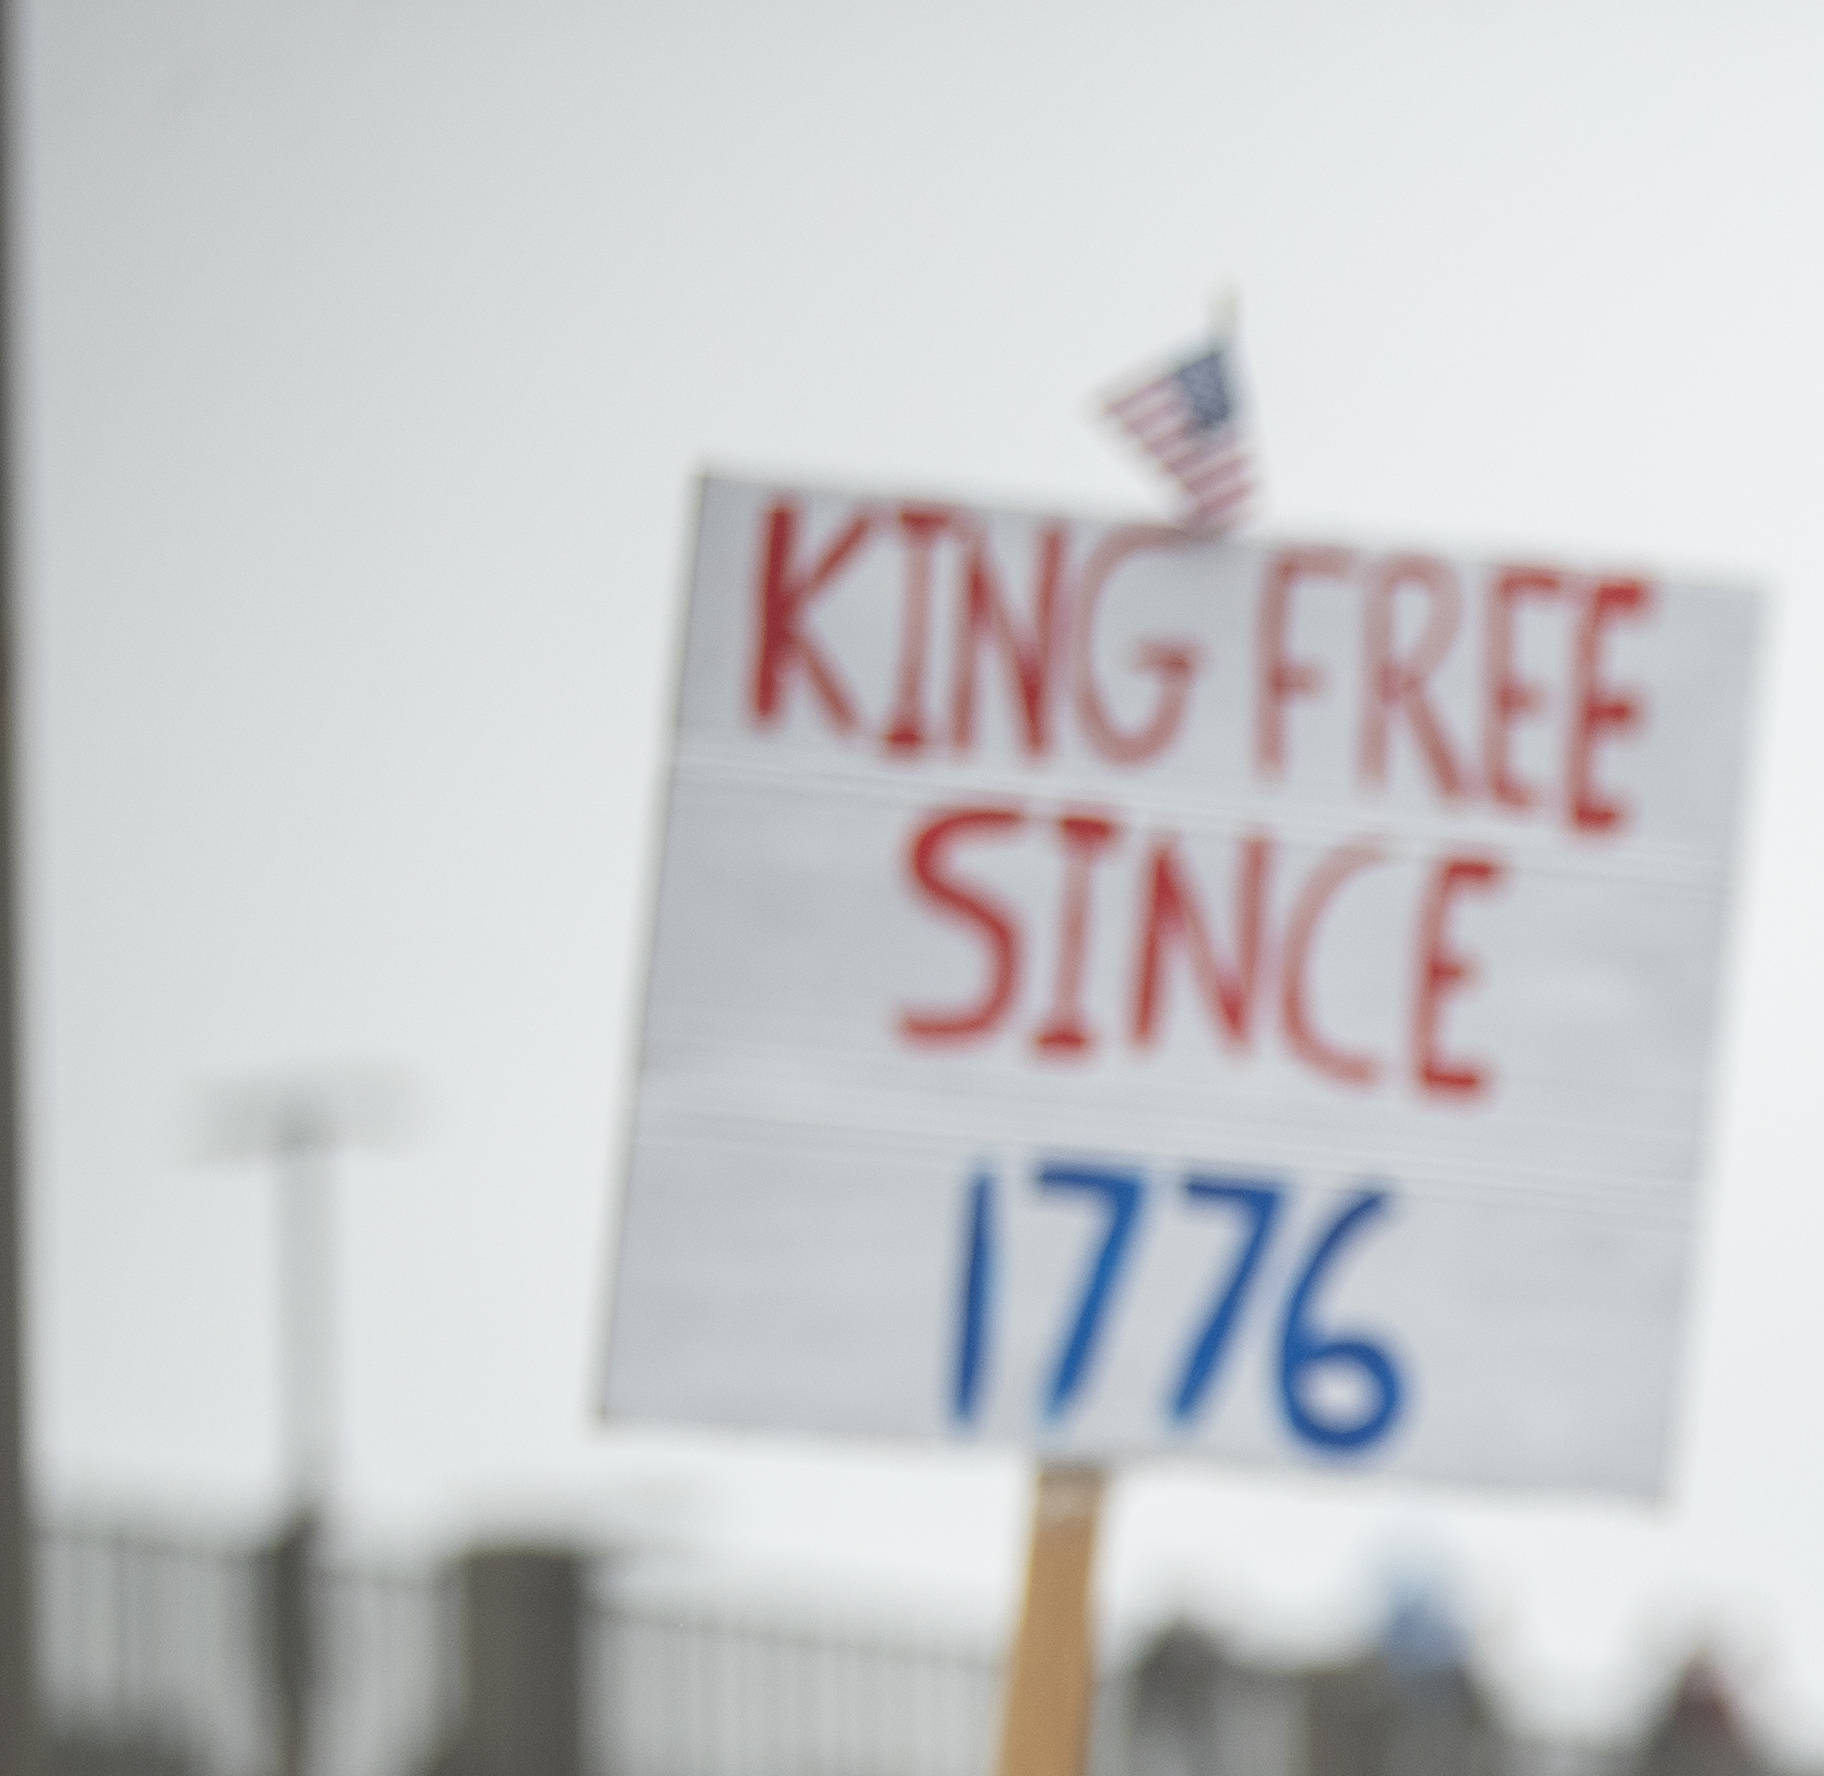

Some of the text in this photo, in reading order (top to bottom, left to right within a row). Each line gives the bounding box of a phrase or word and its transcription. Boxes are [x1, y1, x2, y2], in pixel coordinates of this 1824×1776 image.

[748, 494, 1660, 838] KING FREE
[894, 804, 1505, 1102] SINCE
[944, 1156, 1414, 1468] 1776
